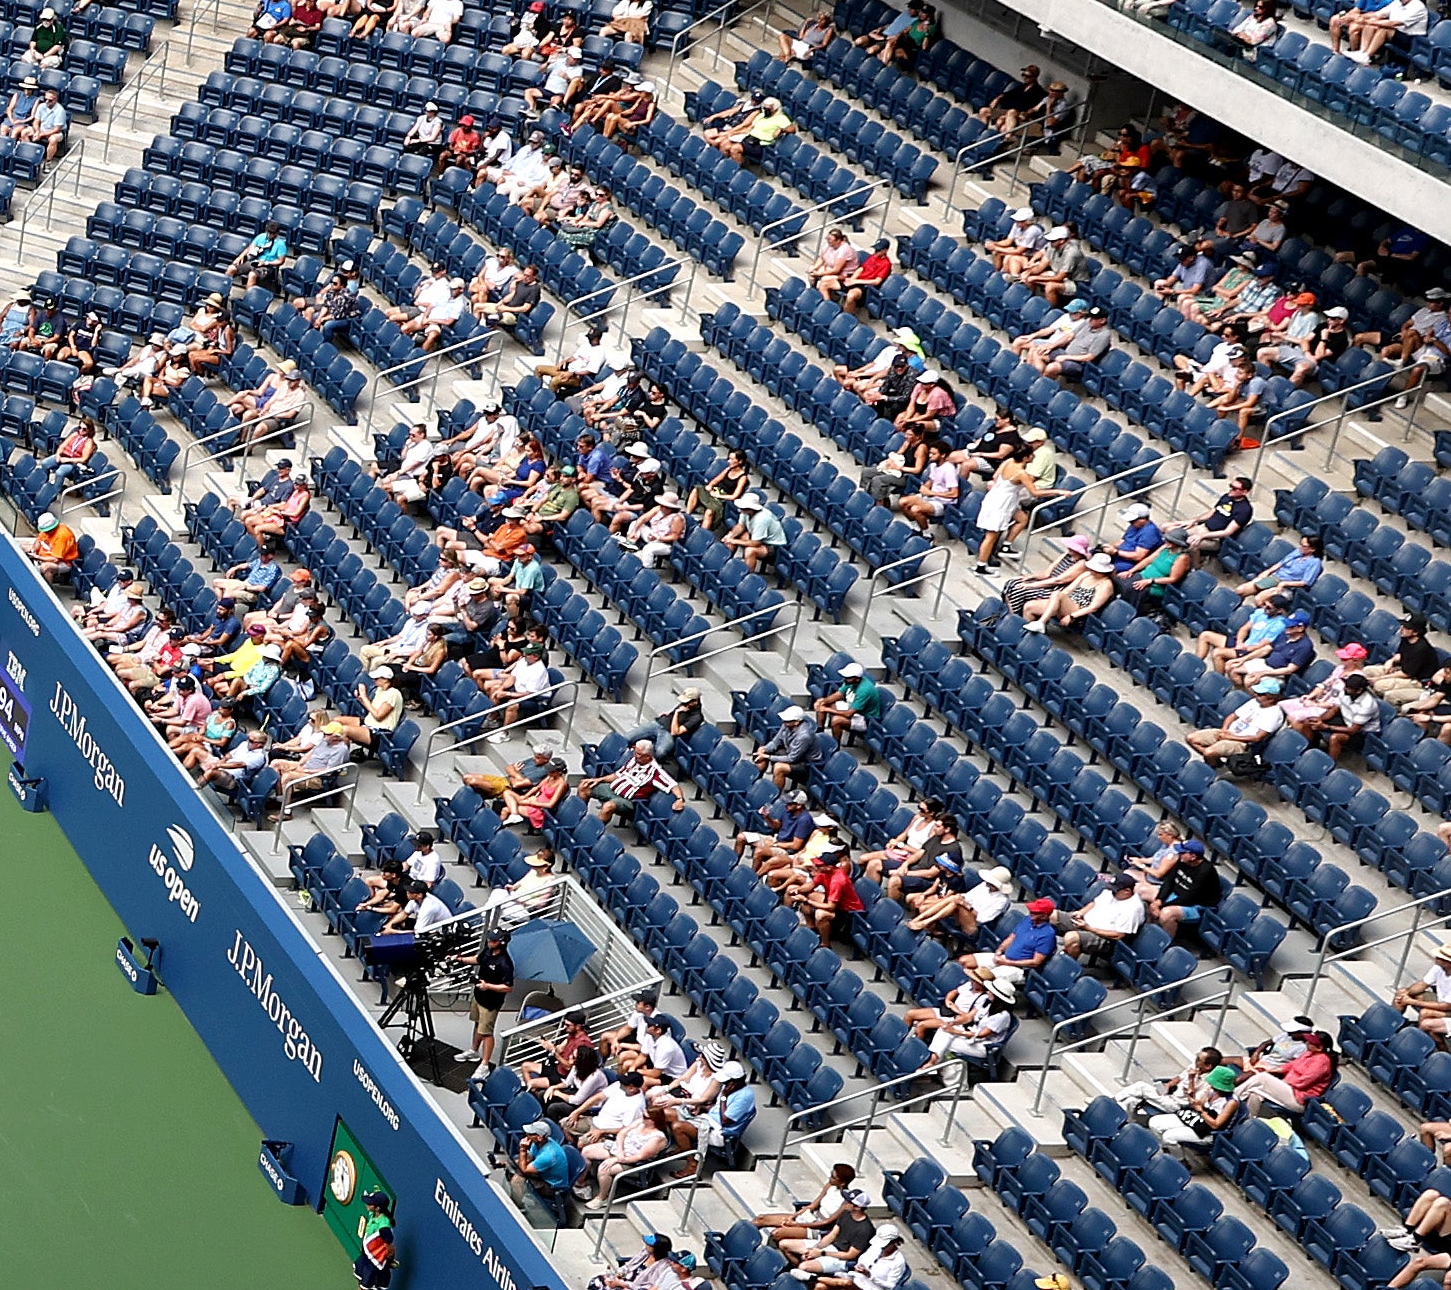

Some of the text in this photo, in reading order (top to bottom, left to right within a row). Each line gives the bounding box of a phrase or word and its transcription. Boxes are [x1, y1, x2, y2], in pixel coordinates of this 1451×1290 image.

[6, 650, 27, 693] IBM
[49, 681, 126, 808] J.P.Morgan
[227, 929, 324, 1084] J.P.Morgan
[353, 1059, 401, 1131] USOPEN.ORG
[434, 1178, 483, 1257] Emirates
